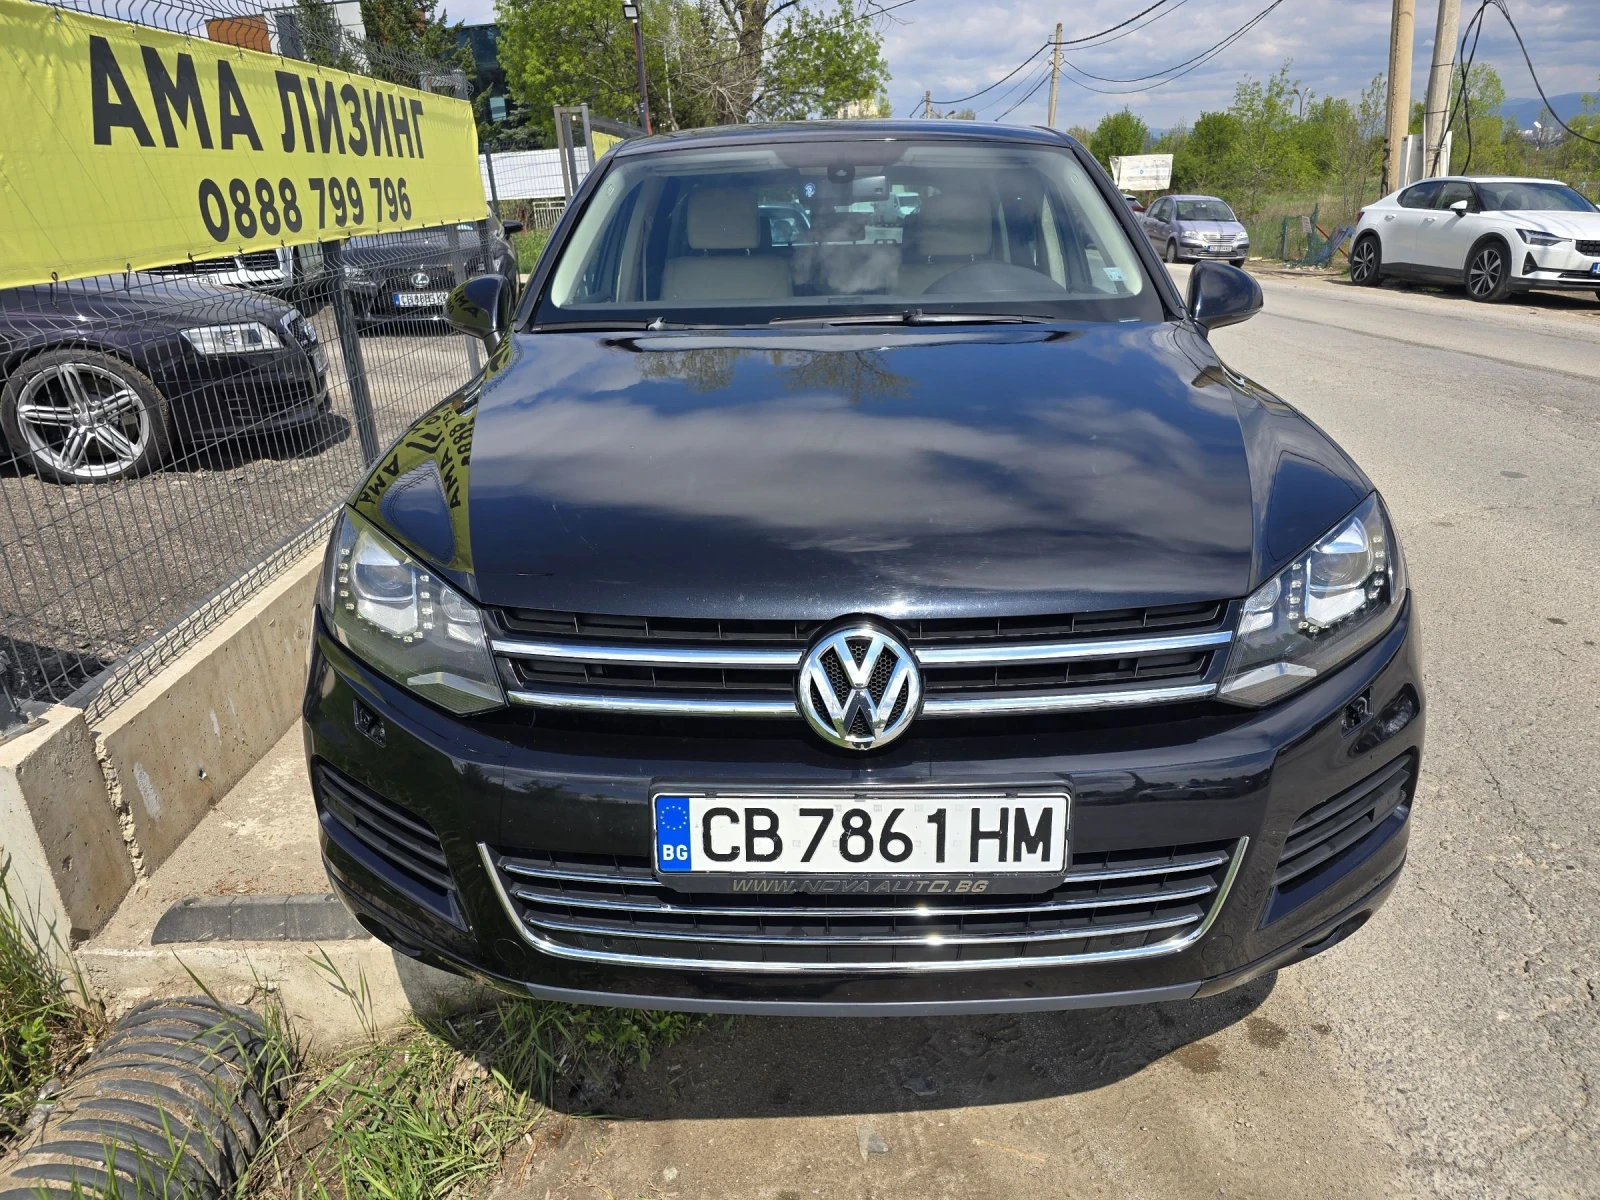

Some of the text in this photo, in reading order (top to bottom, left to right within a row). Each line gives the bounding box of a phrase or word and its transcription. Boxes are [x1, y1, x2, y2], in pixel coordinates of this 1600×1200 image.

[89, 35, 425, 160] АМА ЛИЗИНГ
[198, 176, 413, 243] 0888 799 796
[662, 844, 688, 861] BG
[702, 807, 1053, 864] CB 7861 HM
